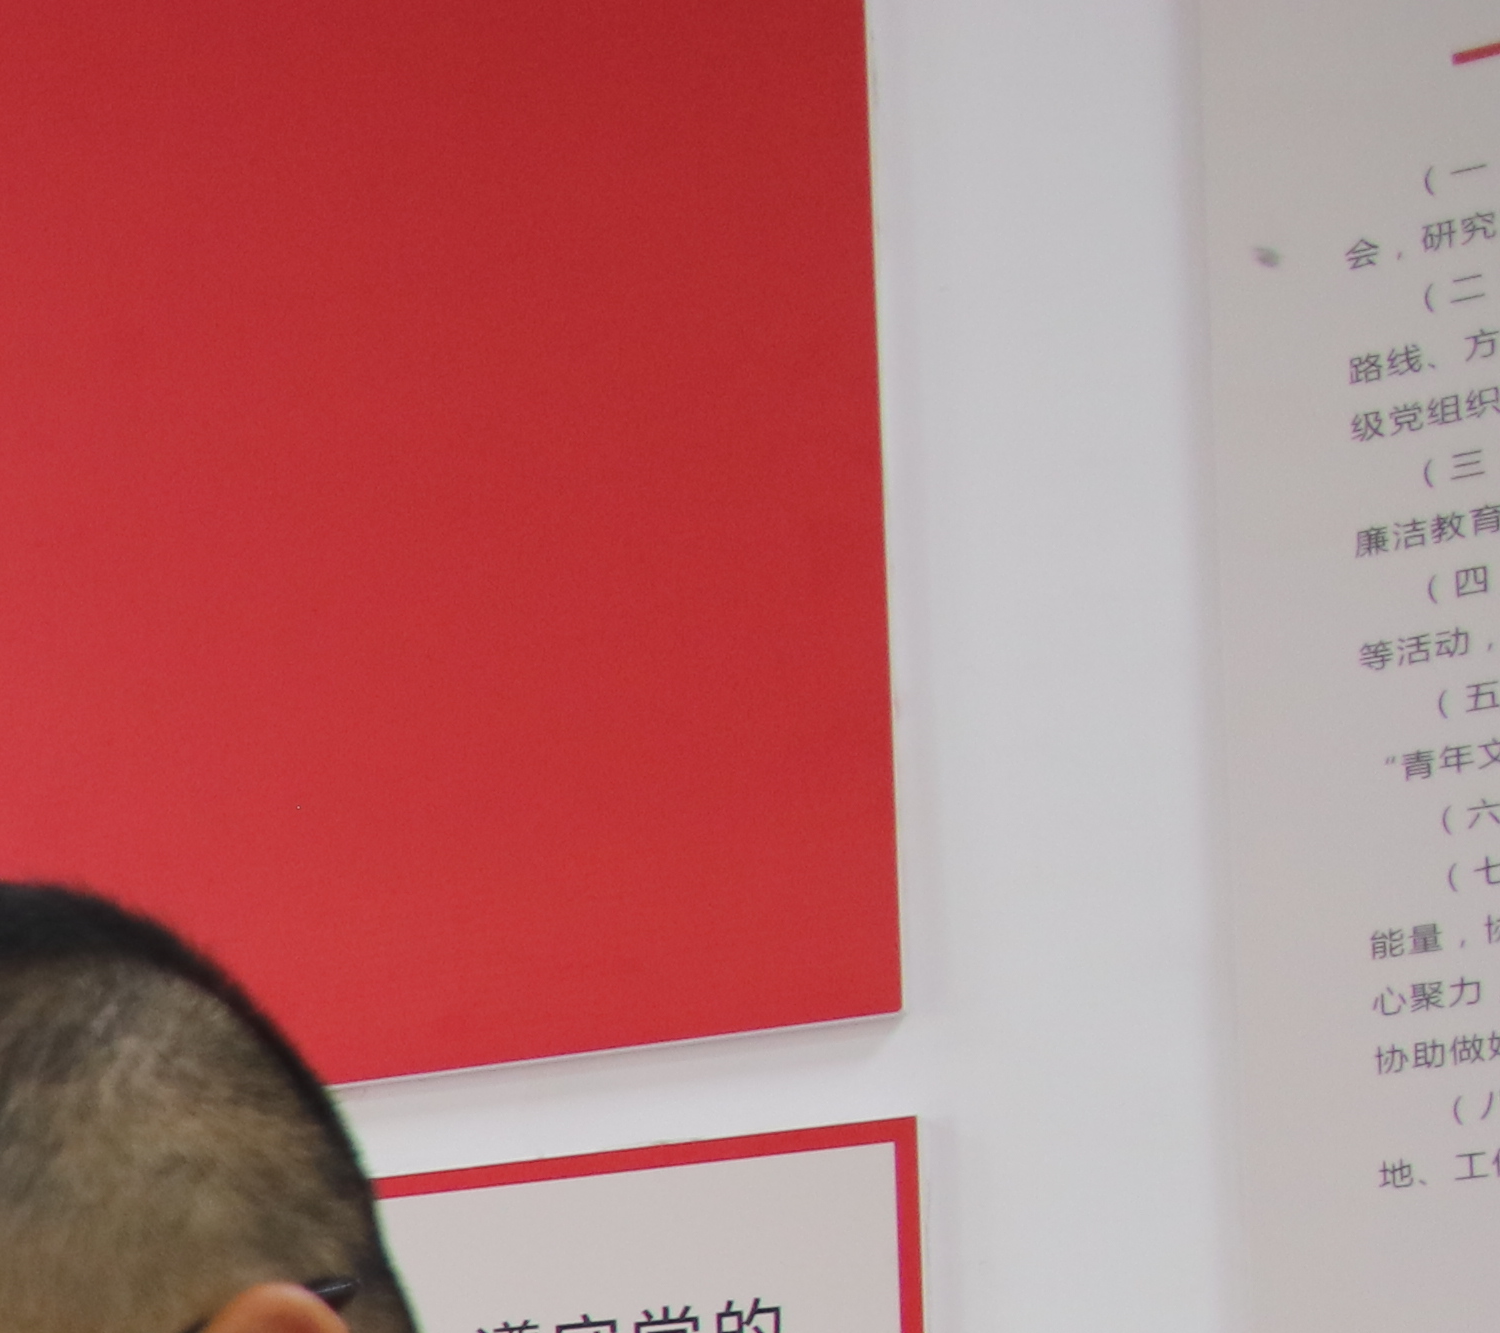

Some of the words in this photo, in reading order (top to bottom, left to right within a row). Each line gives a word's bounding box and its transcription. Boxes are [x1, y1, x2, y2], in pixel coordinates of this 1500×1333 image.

[1371, 975, 1482, 1017] 心聚力
[1379, 1149, 1500, 1190] 地、工
